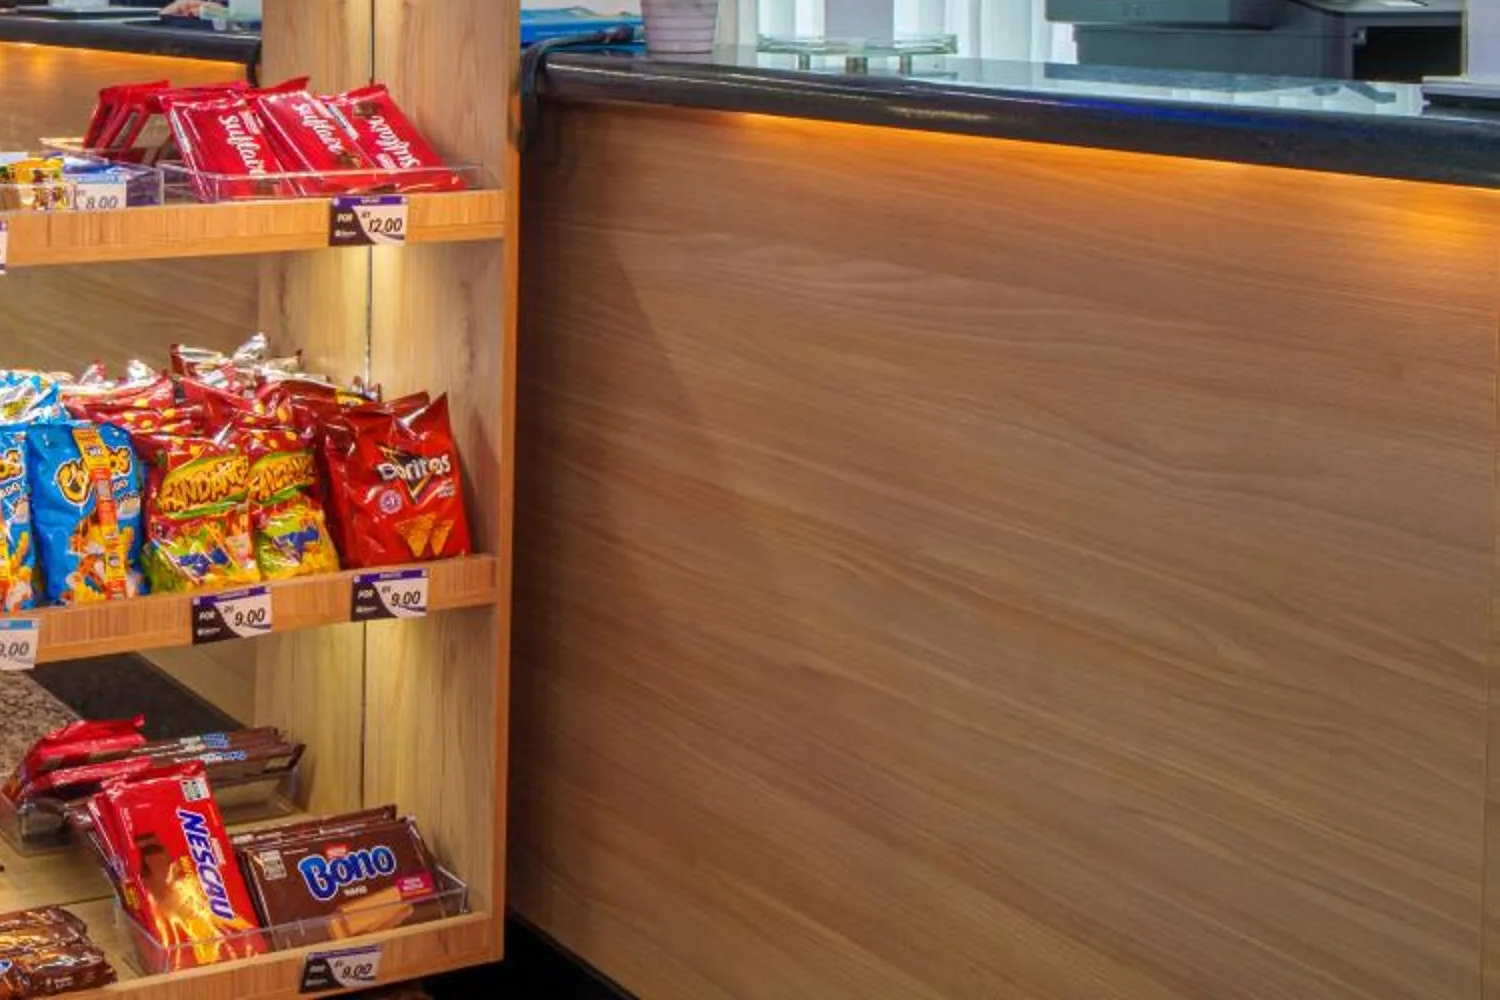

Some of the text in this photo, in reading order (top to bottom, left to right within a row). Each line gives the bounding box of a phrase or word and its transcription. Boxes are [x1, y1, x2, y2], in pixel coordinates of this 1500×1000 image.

[337, 213, 353, 223] POR
[377, 454, 452, 482] Doritos
[390, 590, 422, 607] 9,00
[199, 610, 216, 621] POR
[234, 608, 266, 627] 9,00
[176, 807, 235, 920] NESCAU
[298, 846, 397, 901] Bono
